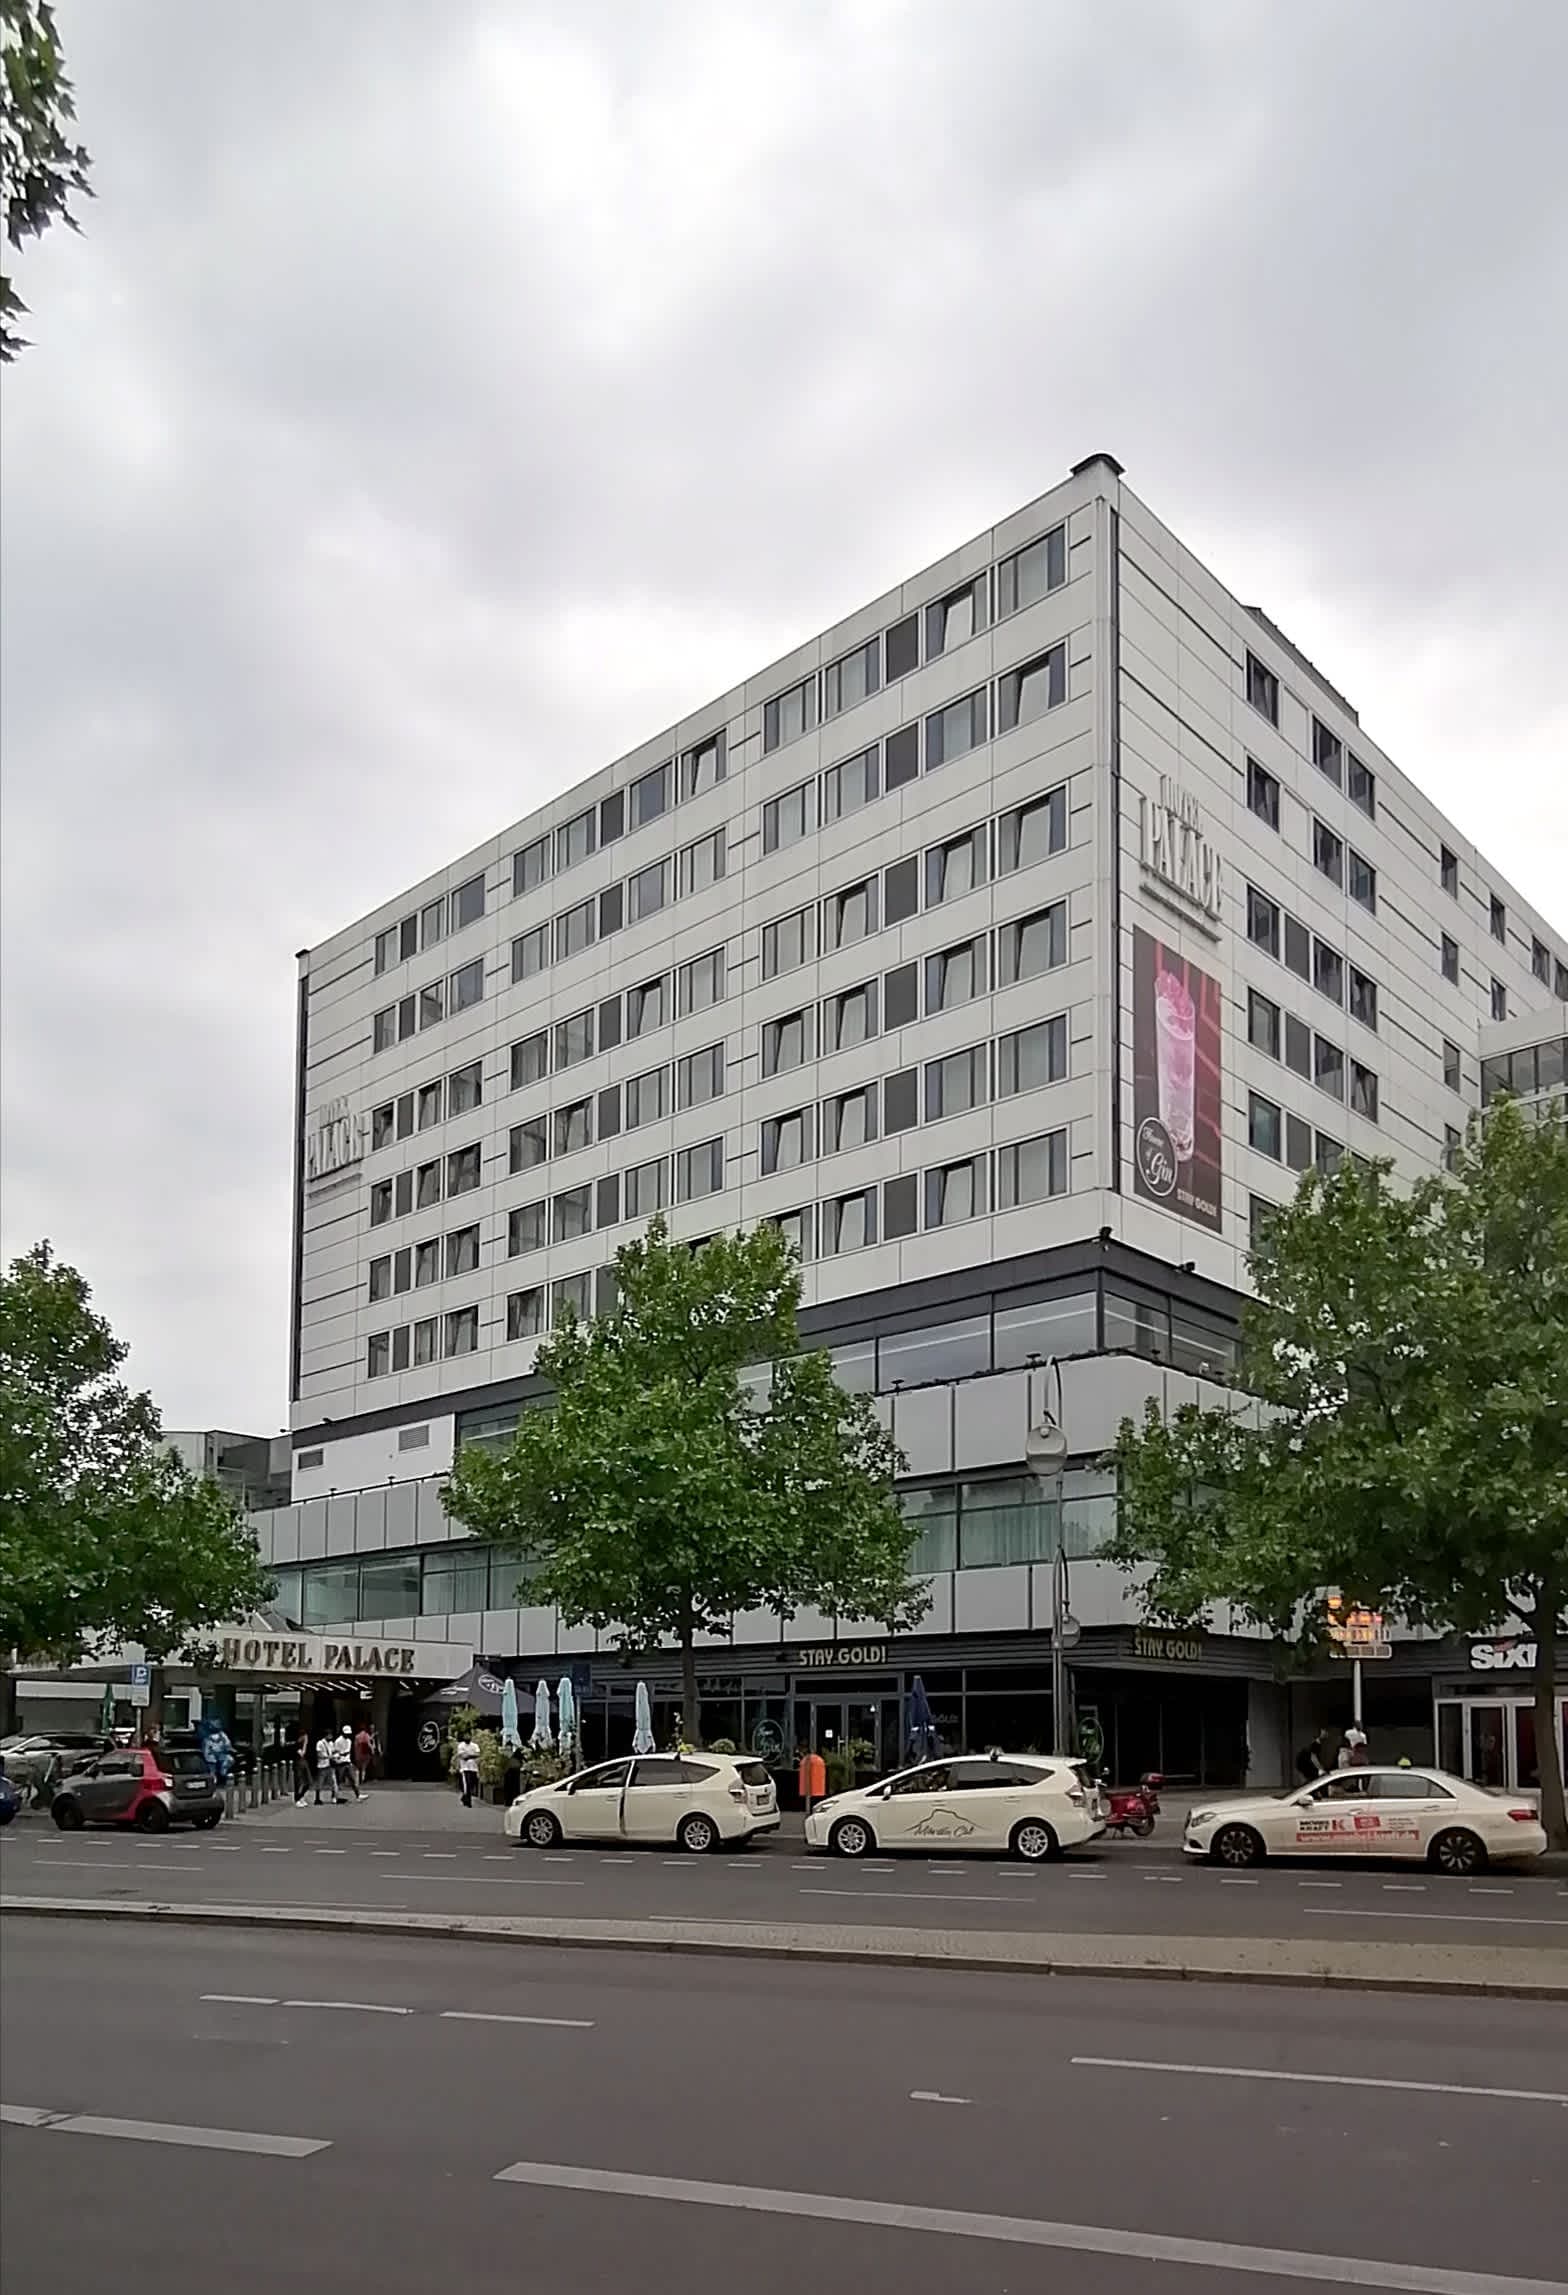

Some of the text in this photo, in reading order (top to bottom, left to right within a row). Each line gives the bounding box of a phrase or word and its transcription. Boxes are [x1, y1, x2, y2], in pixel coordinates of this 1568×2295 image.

[1146, 1152, 1173, 1185] Gin
[223, 1637, 416, 1673] HOTEL PALACE
[799, 1645, 886, 1666] STAY GOLD!
[1134, 1636, 1164, 1657] STAY
